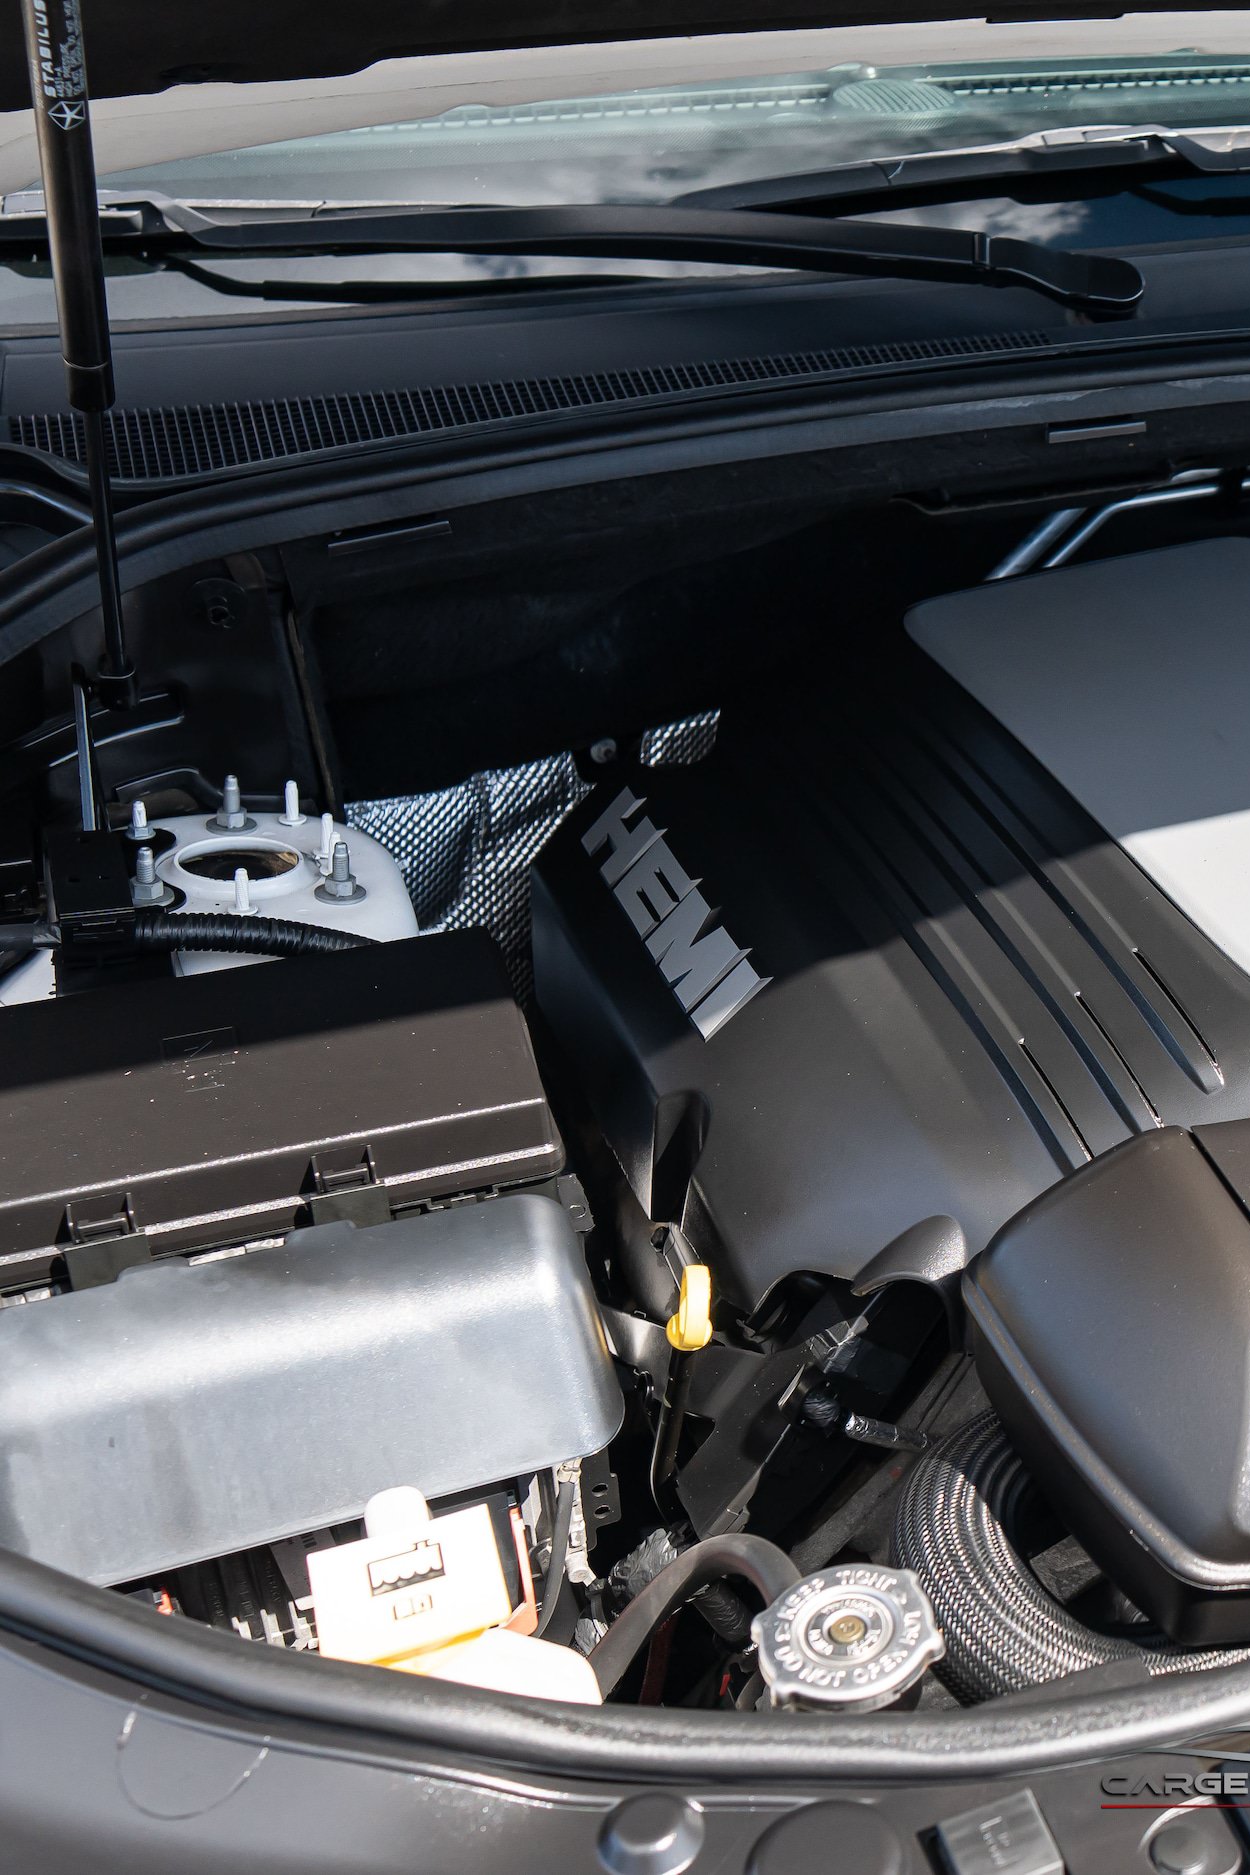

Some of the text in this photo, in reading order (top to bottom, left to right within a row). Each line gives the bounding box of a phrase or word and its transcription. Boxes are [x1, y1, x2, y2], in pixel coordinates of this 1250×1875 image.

[581, 786, 774, 1043] HEMI
[836, 1570, 898, 1592] TIGHT
[798, 1664, 847, 1688] NOT
[853, 1650, 909, 1684] OPEN
